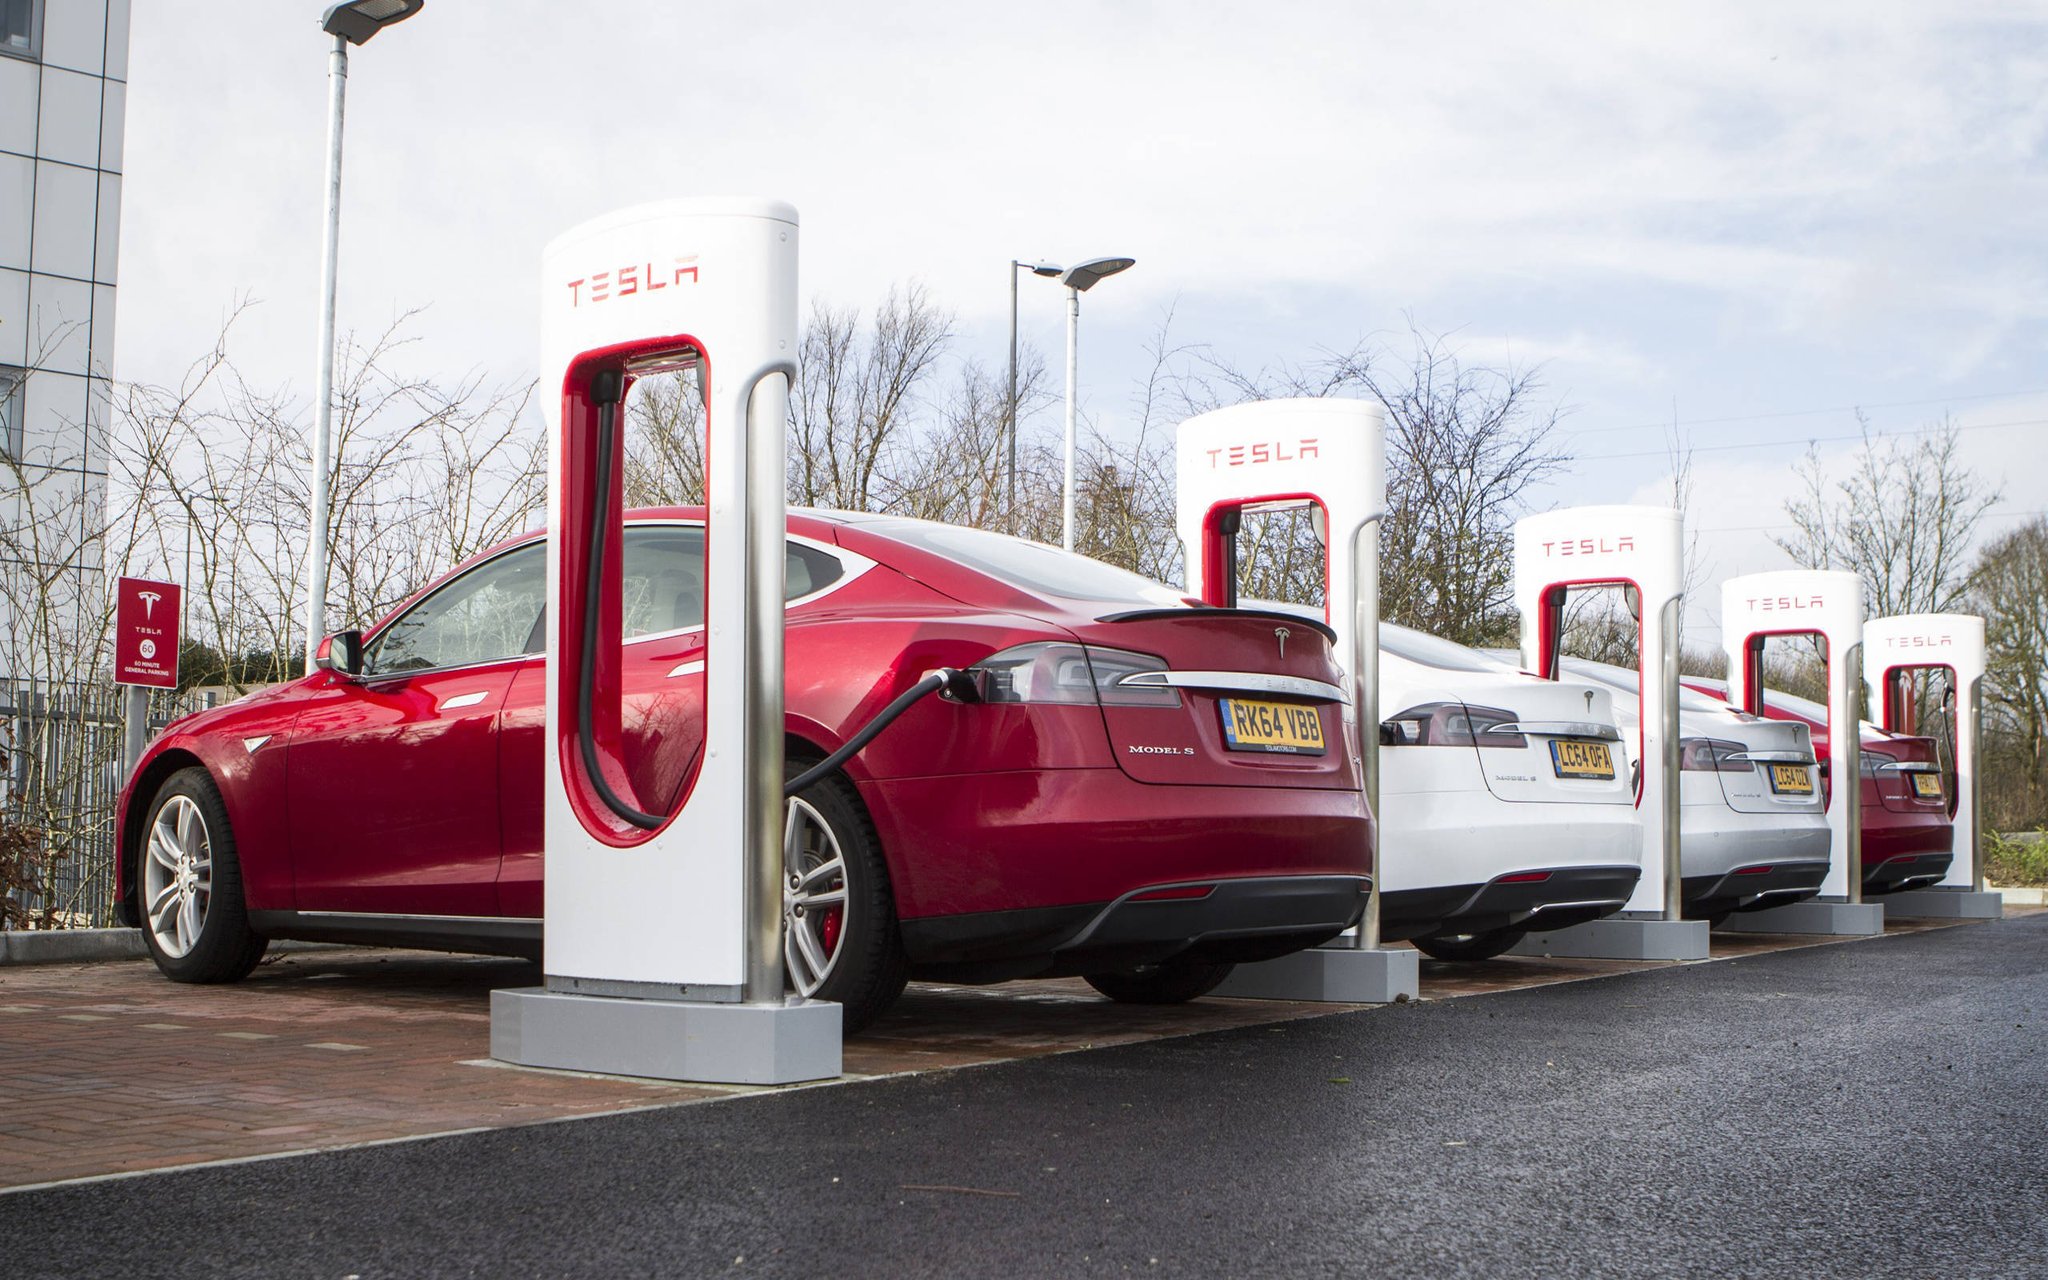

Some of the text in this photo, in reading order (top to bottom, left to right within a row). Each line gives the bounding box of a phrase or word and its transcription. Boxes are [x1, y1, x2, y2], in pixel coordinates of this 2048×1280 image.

[567, 255, 700, 308] TESLA
[1206, 438, 1319, 469] TESLA
[1542, 536, 1634, 557] TESLA
[1747, 595, 1824, 611] TESLA
[135, 626, 162, 635] TESLA
[142, 644, 153, 653] 60
[1885, 635, 1952, 648] TESLA
[1234, 704, 1320, 741] RK64 VBB
[1129, 746, 1194, 755] MODEL S
[1558, 743, 1611, 769] LC64 OFA
